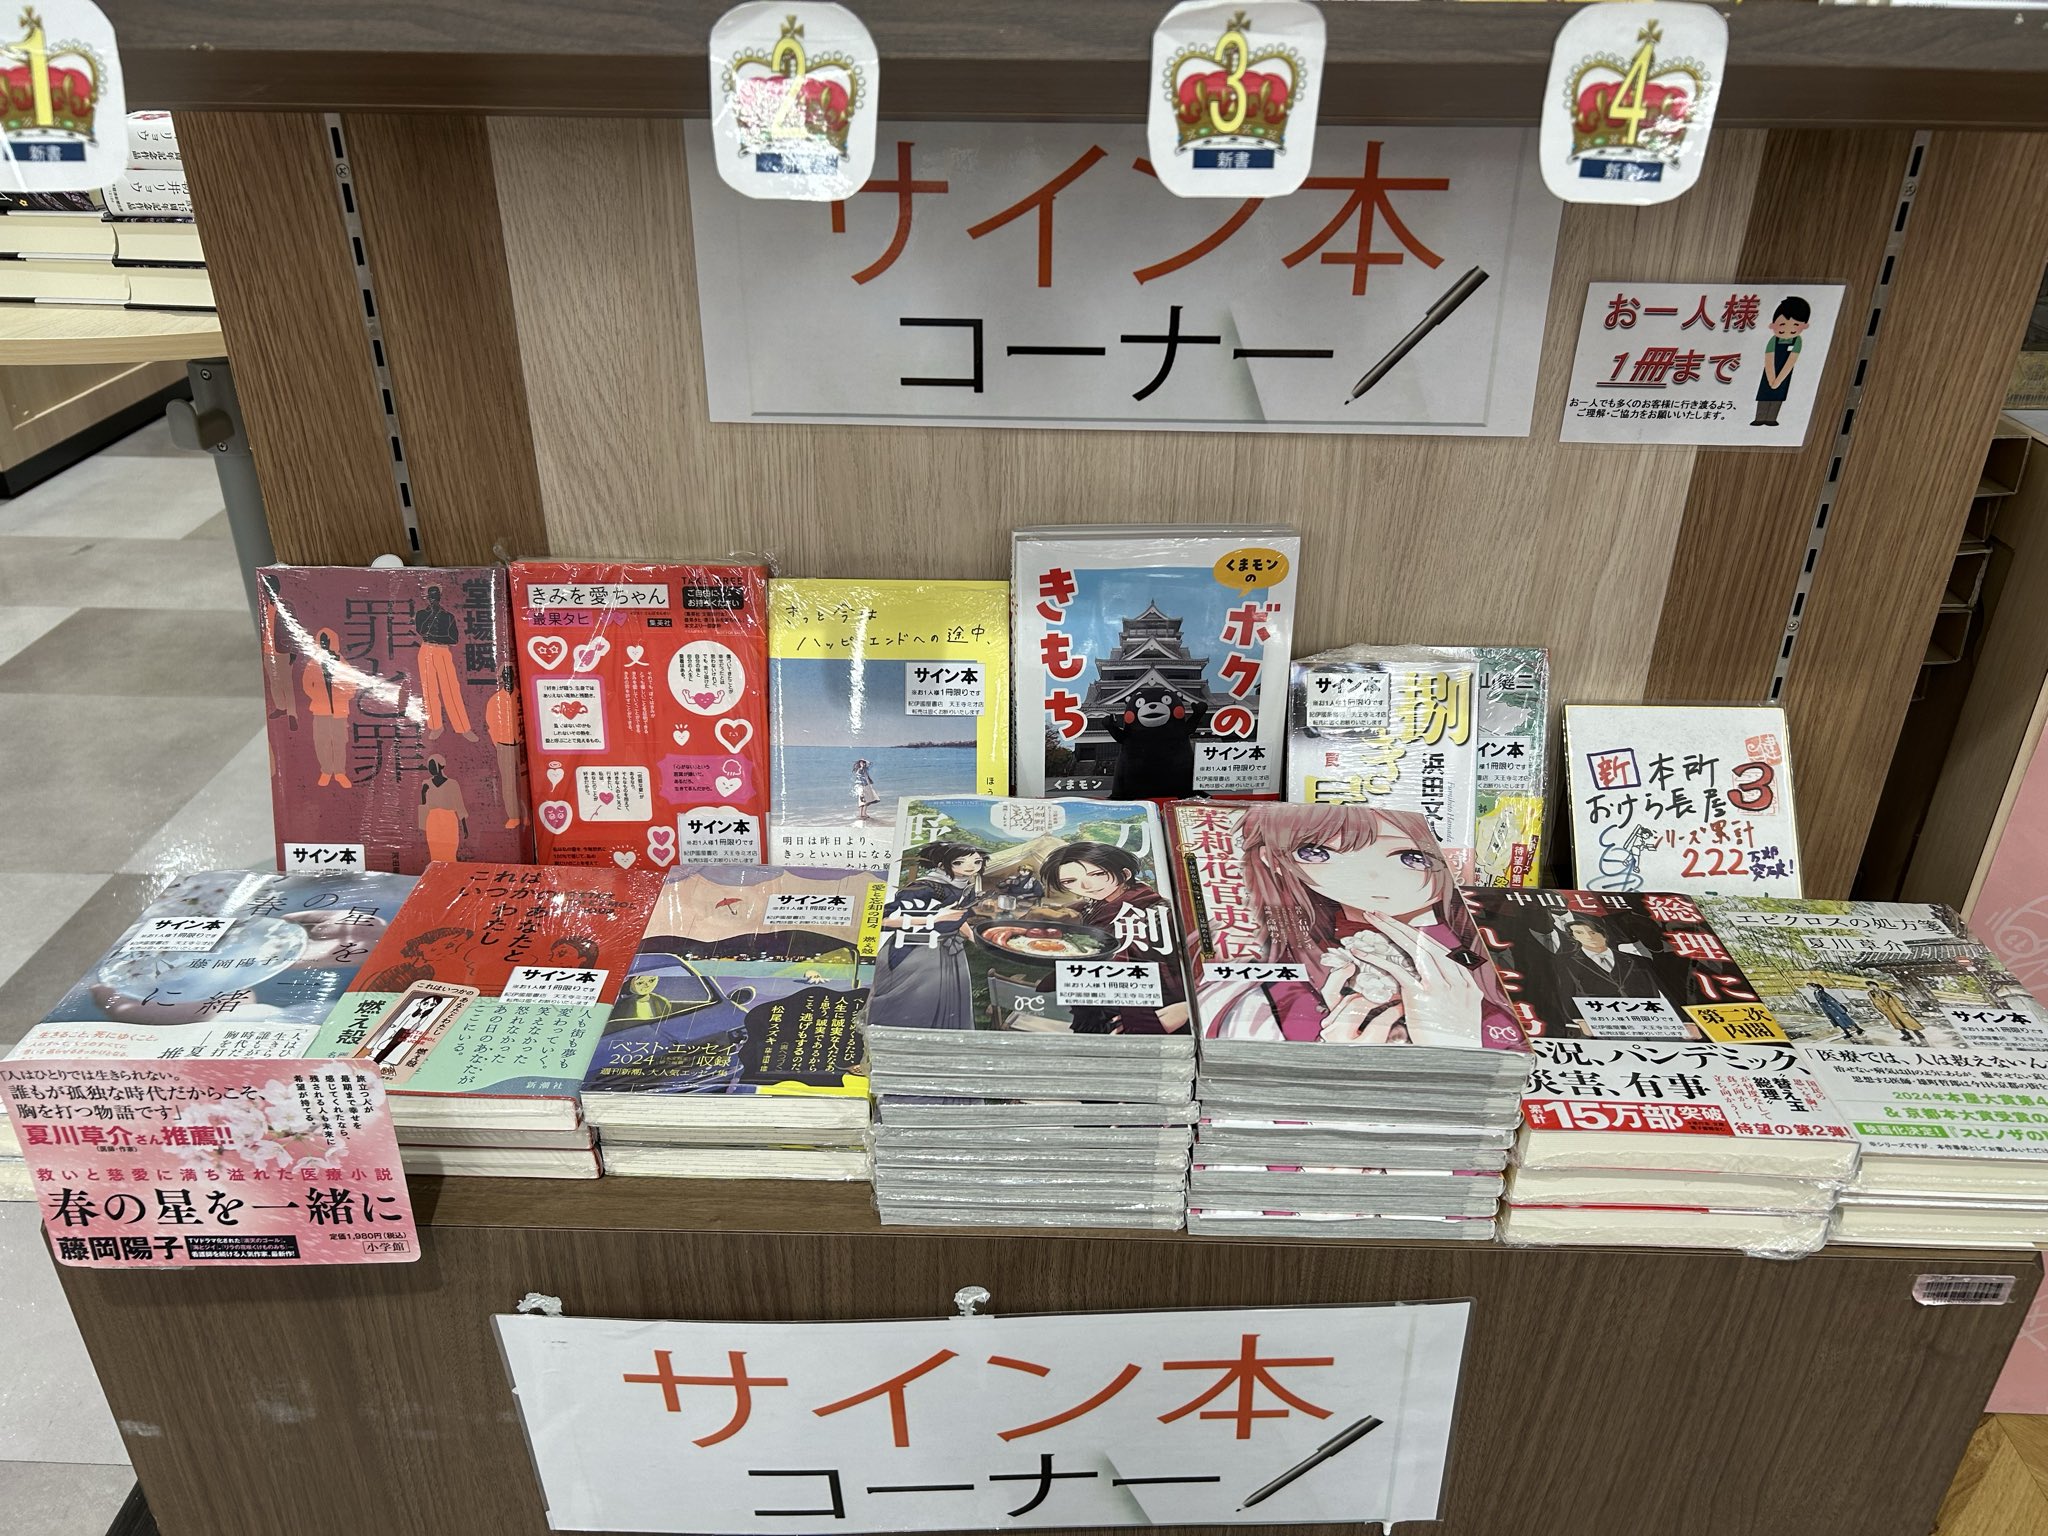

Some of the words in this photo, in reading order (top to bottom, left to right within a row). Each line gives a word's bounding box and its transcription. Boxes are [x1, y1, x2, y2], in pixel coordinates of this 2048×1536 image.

[7, 27, 54, 126] 1
[1209, 30, 1249, 134] 3
[1609, 43, 1655, 144] 4
[28, 144, 62, 161] 新書
[1216, 151, 1251, 169] 新書
[832, 141, 1450, 296] サイン本
[1603, 293, 1761, 331] お一人様
[899, 305, 1334, 402] コーナー
[1609, 346, 1742, 384] 1冊まで
[1569, 397, 1737, 411] お一人でも多くのお客様に行き渡るよう、
[1576, 408, 1726, 421] ご理解・ご協力をお願いいたします。
[1226, 559, 1278, 572] くまモン
[1245, 573, 1256, 583] の
[532, 586, 666, 606] きみを愛ちゃん
[533, 612, 590, 626] 最果タヒ
[649, 619, 671, 627] 集英社
[462, 577, 498, 686] 堂場瞬一
[796, 625, 990, 651] ハッピエンドへの途中、
[1036, 567, 1086, 739] きもち
[914, 667, 978, 684] サイン本
[1213, 602, 1281, 737] ボクの
[912, 688, 981, 696] ※お1人様1冊限りです
[1316, 677, 1380, 693] サイン本
[1204, 745, 1266, 760] サイン本
[1478, 741, 1525, 758] イン本
[1597, 755, 1630, 787] 新
[1648, 753, 1719, 791] 本所
[1054, 779, 1102, 790] くまモン
[1586, 787, 1727, 829] おけら長屋
[1727, 762, 1775, 811] 3
[688, 818, 750, 835] サイン本
[1652, 819, 1754, 849] シリーズ累計
[782, 836, 874, 846] 明日は昨日より、
[293, 847, 357, 864] サイン本
[784, 850, 892, 859] きっといい日になる
[1681, 848, 1749, 878] 222
[471, 870, 541, 884] これは
[1192, 807, 1263, 961] 茉莉花官吏伝
[1111, 821, 1174, 956] 刀剣
[778, 895, 847, 906] サイン本
[866, 883, 886, 928] 愛と忘却の日々
[1506, 891, 1632, 911] 中山七里
[156, 919, 225, 931] サイン本
[481, 902, 518, 946] わたし
[504, 905, 549, 962] あなたと
[1736, 914, 1950, 934] エピクロスの処方箋
[1647, 894, 1756, 1001] 総理に
[1808, 937, 1905, 951] 夏川草介
[188, 956, 279, 969] 藤岡陽子
[1066, 964, 1149, 979] サイン本
[522, 969, 598, 983] サイン本
[1214, 966, 1300, 980] サイン本
[417, 982, 475, 996] これはいつかの
[1585, 1000, 1664, 1013] サイン本
[1698, 1005, 1773, 1024] 第二次
[336, 1000, 387, 1045] 燃え殻
[766, 1005, 785, 1045] 松尾スズキ
[1951, 1010, 2032, 1025] サイン本
[454, 1005, 484, 1056] ここにいる。
[491, 1006, 530, 1064] 怒れなかった
[514, 1006, 551, 1064] 笑えなかった
[538, 1007, 573, 1069] 変わっていく。
[559, 1009, 592, 1069] 人も街も夢も
[1726, 1023, 1776, 1038] 内閣
[457, 1005, 507, 1085] あの日のあなたが
[608, 1040, 738, 1056] 「ベスト・エッセイ
[609, 1053, 655, 1066] 2024
[0, 1069, 181, 1083] 「人はひとりでは生きられない。
[600, 1066, 728, 1078] 週刊新潮、大人気エッセイ集
[10, 1085, 268, 1102] 誰もが孤独な時代だからこそ、
[356, 1074, 375, 1114] 旅立つ人が
[525, 1081, 563, 1089] 新潮社
[1525, 1068, 1712, 1100] 災害、有事
[293, 1074, 316, 1126] 希望が持てる。
[309, 1074, 336, 1146] 残される人も未来に
[325, 1074, 351, 1140] 感じてくれたなら、
[340, 1074, 362, 1130] 最期まで幸せを
[17, 1103, 183, 1122] 胸を打つ物語です」
[1528, 1103, 1546, 1124] 累計
[1543, 1100, 1726, 1131] 15万部突破
[1734, 1121, 1853, 1139] 待望の第2弾!
[1862, 1124, 1942, 1137] 映画化決定!
[36, 1167, 394, 1182] 救いと慈愛に満ち溢れた医療小説
[47, 1186, 403, 1228] 春の星を一緒に
[56, 1235, 184, 1261] 藤岡陽子
[367, 1241, 405, 1253] 小学館
[622, 1333, 1335, 1448] サイン本
[747, 1453, 1221, 1519] コーナー
